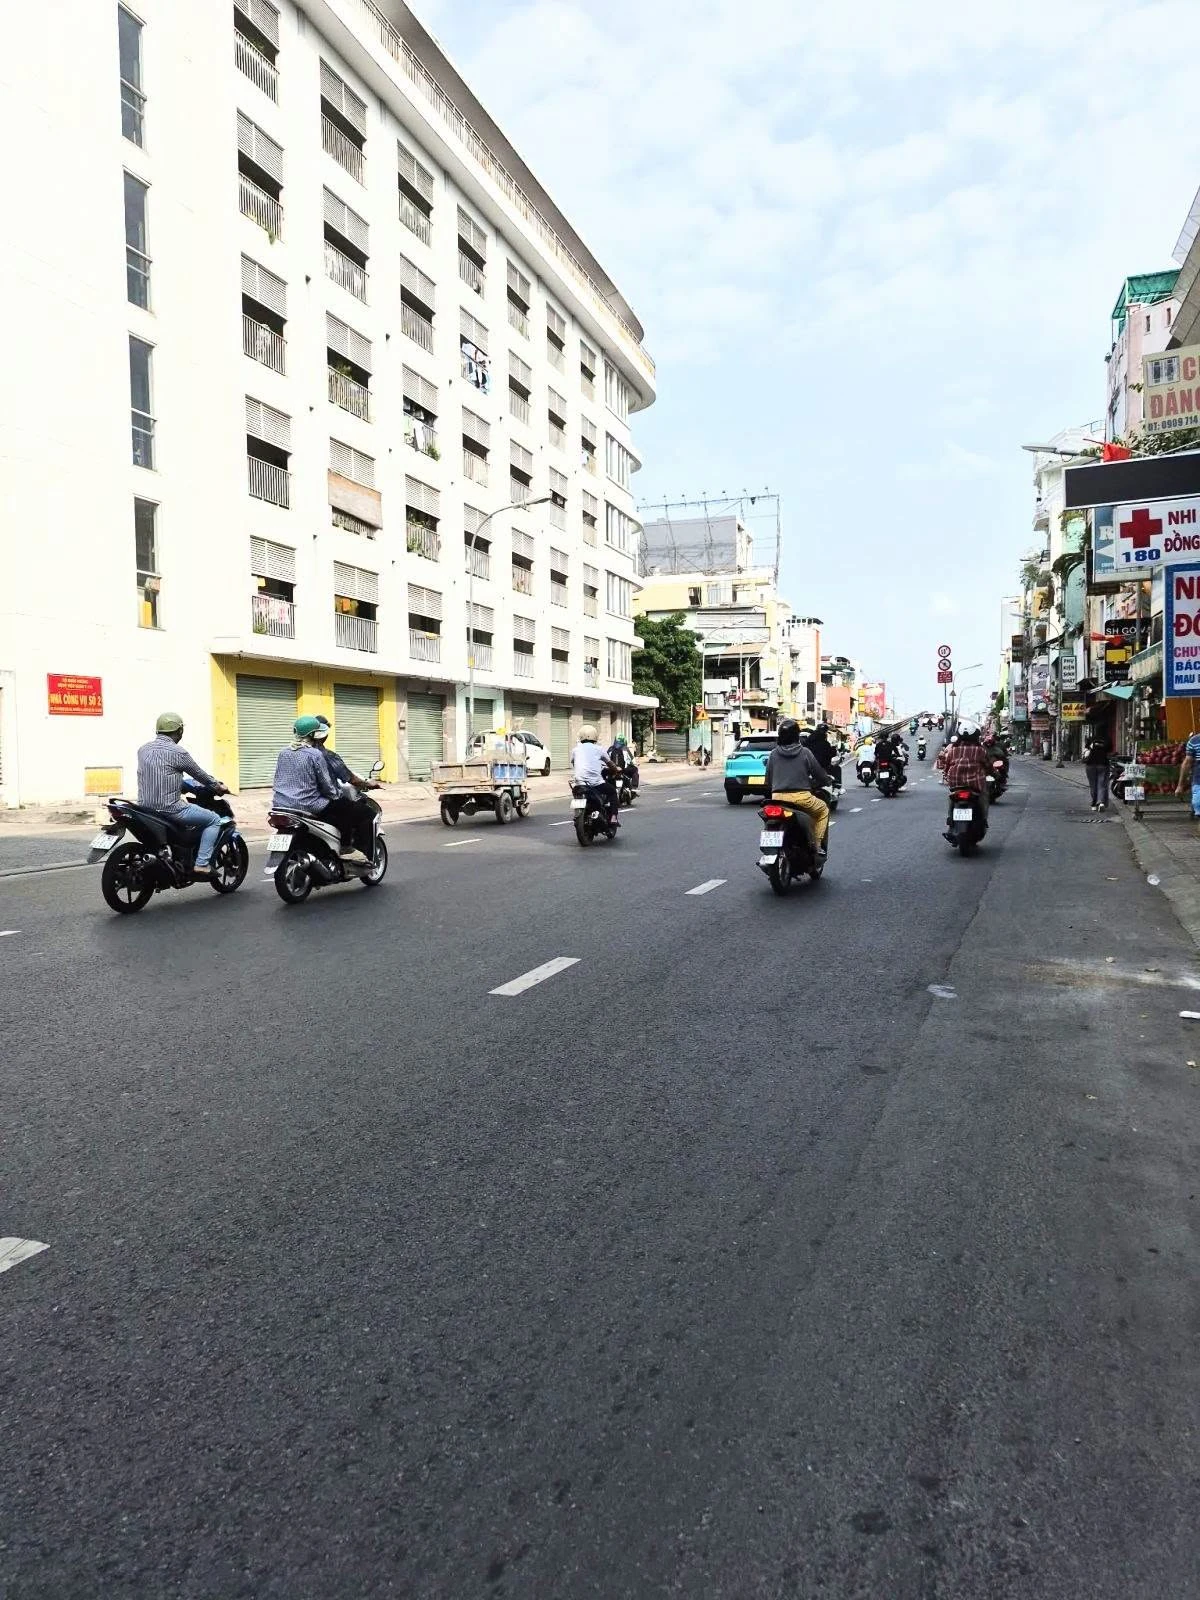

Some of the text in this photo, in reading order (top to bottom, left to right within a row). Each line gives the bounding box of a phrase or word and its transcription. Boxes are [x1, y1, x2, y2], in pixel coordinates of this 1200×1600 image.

[1183, 357, 1200, 380] C
[1162, 417, 1183, 429] 0909
[1185, 415, 1198, 425] 714
[1168, 509, 1196, 525] NHI
[1122, 549, 1160, 562] 180
[1175, 576, 1200, 600] N
